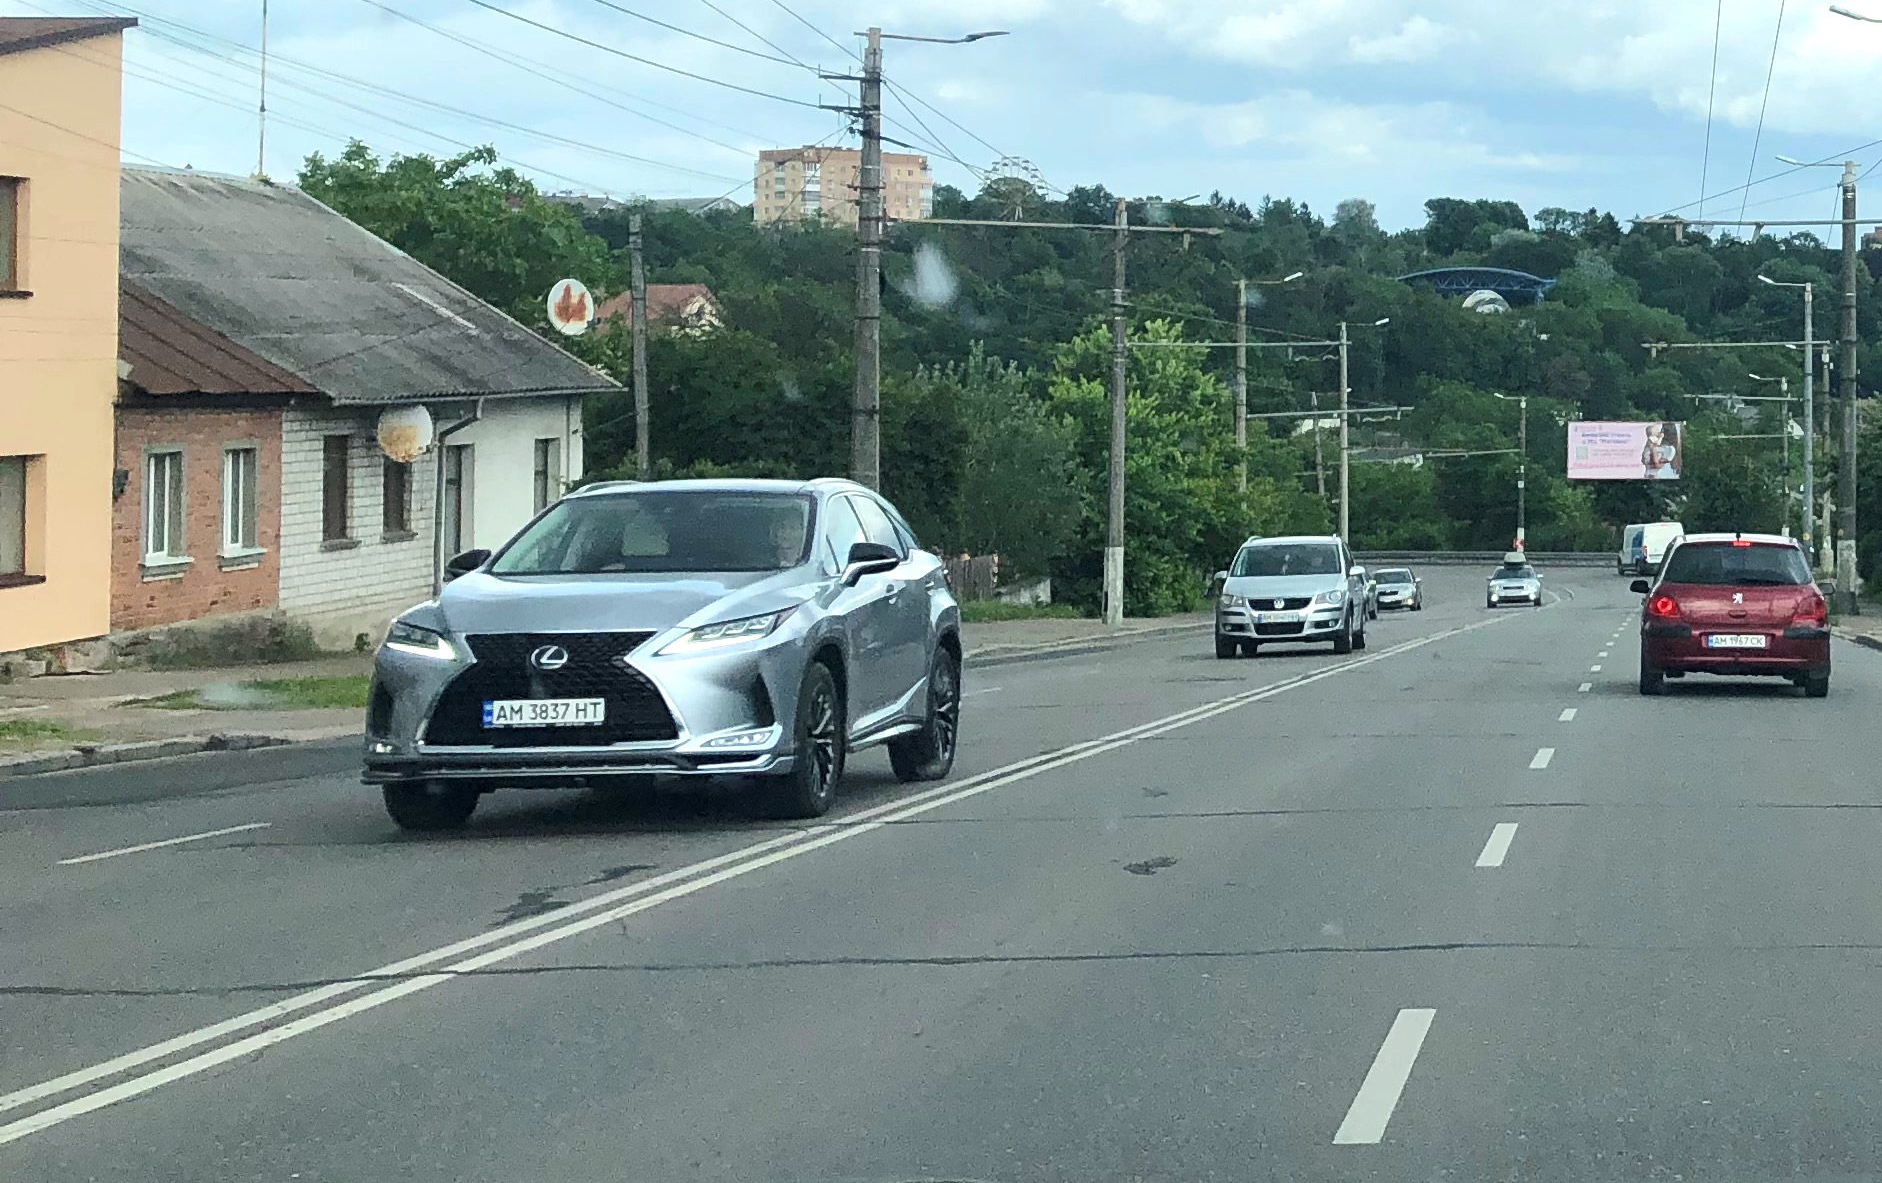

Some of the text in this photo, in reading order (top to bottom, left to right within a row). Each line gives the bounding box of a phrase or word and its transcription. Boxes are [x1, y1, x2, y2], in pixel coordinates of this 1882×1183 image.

[495, 701, 602, 722] AM 3837 HT
